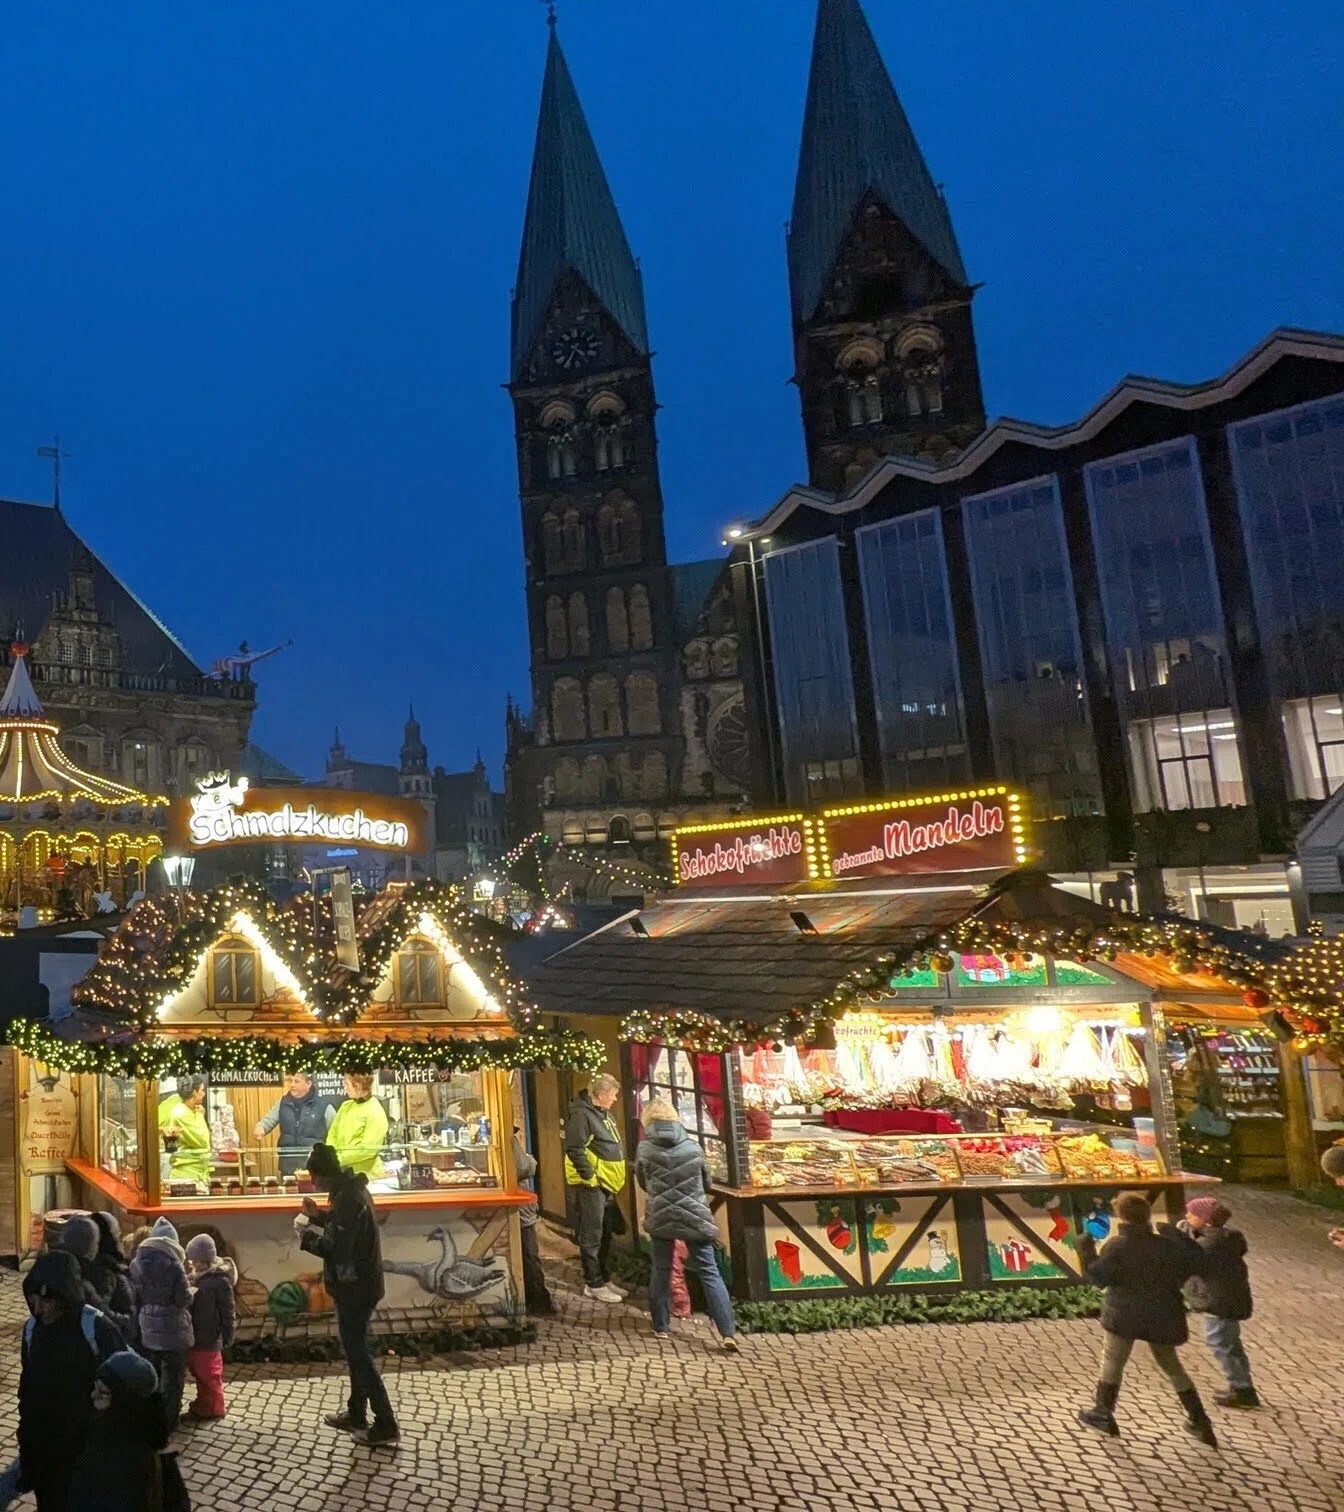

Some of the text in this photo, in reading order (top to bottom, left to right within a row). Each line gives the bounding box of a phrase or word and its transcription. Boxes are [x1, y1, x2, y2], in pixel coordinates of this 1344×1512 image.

[190, 804, 409, 847] Schmalzkuchen
[832, 800, 1005, 875] gebrannte Mandeln
[679, 826, 802, 880] Schokofrüchte
[394, 1069, 435, 1083] KAFFEE
[317, 1088, 336, 1097] guten
[28, 1146, 66, 1160] Kaffee
